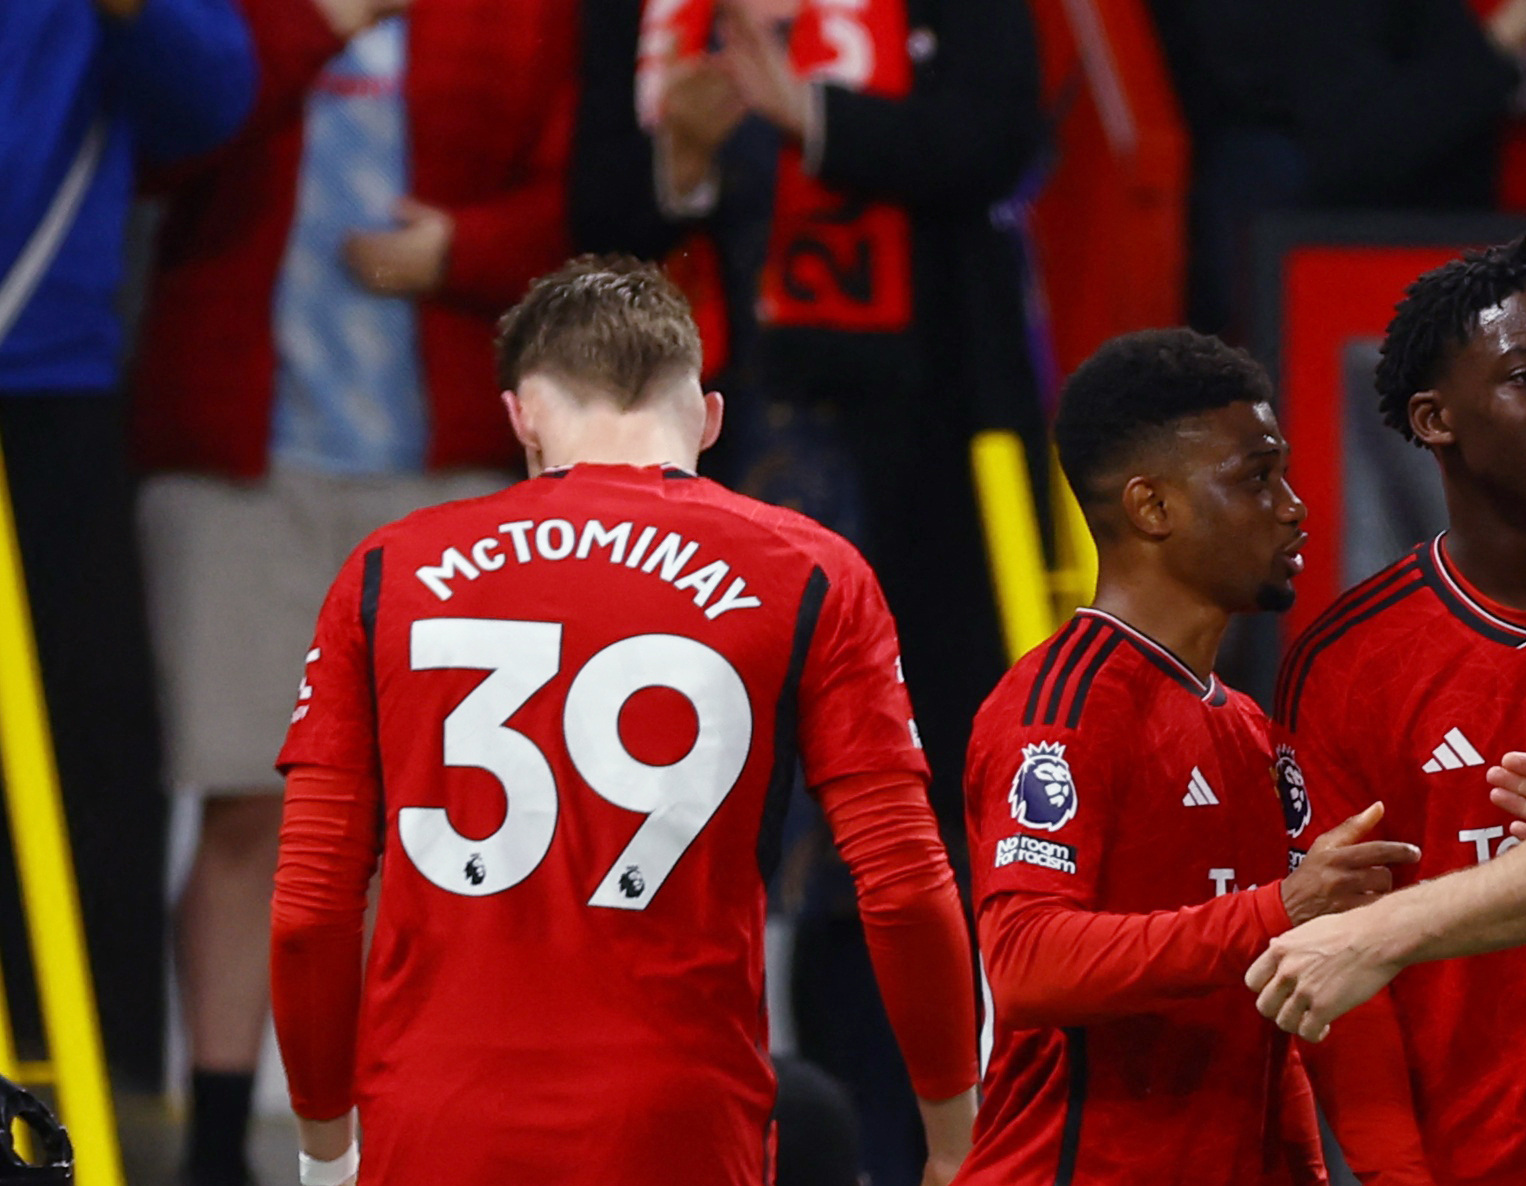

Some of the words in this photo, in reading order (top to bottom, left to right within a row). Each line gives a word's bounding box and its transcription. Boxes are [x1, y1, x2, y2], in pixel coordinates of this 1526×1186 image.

[398, 617, 753, 912] 39
[998, 836, 1019, 852] No
[1020, 836, 1070, 860] room
[1018, 848, 1077, 874] racism
